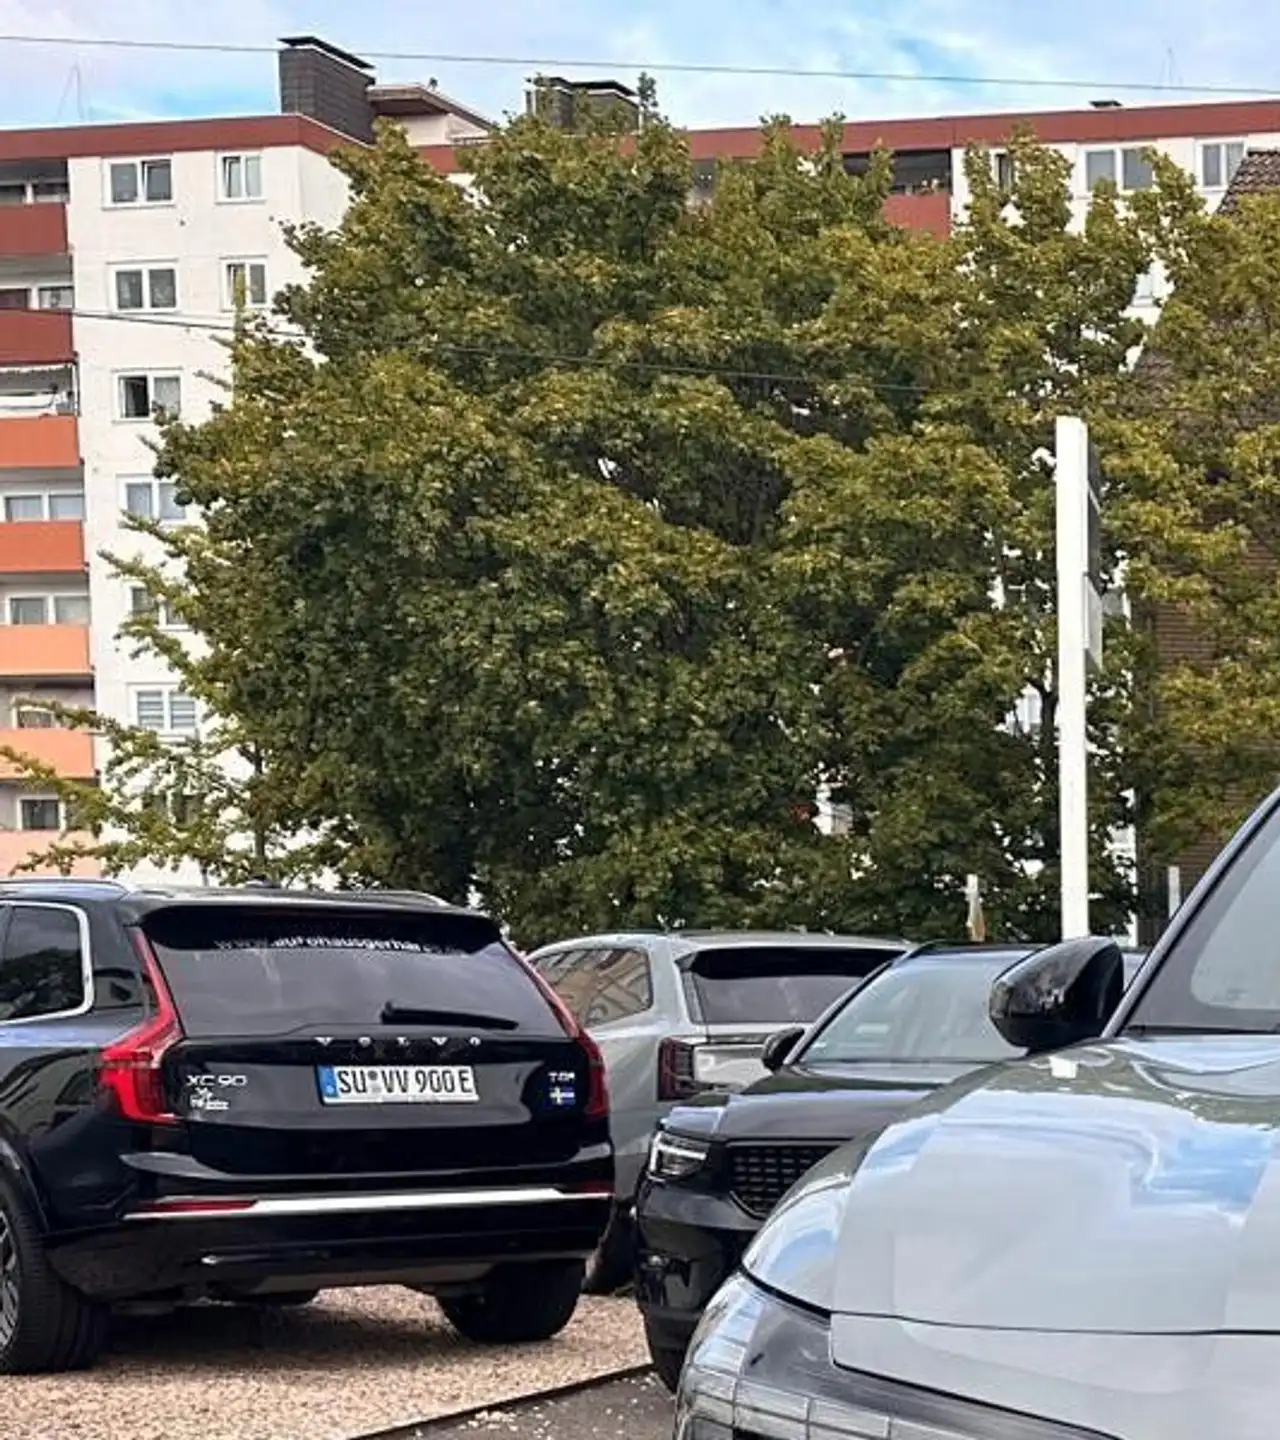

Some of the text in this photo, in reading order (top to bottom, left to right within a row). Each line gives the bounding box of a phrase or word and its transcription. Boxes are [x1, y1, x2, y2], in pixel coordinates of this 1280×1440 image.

[314, 1036, 482, 1047] VOLVO
[337, 1069, 367, 1094] SU
[381, 1069, 410, 1094] VV
